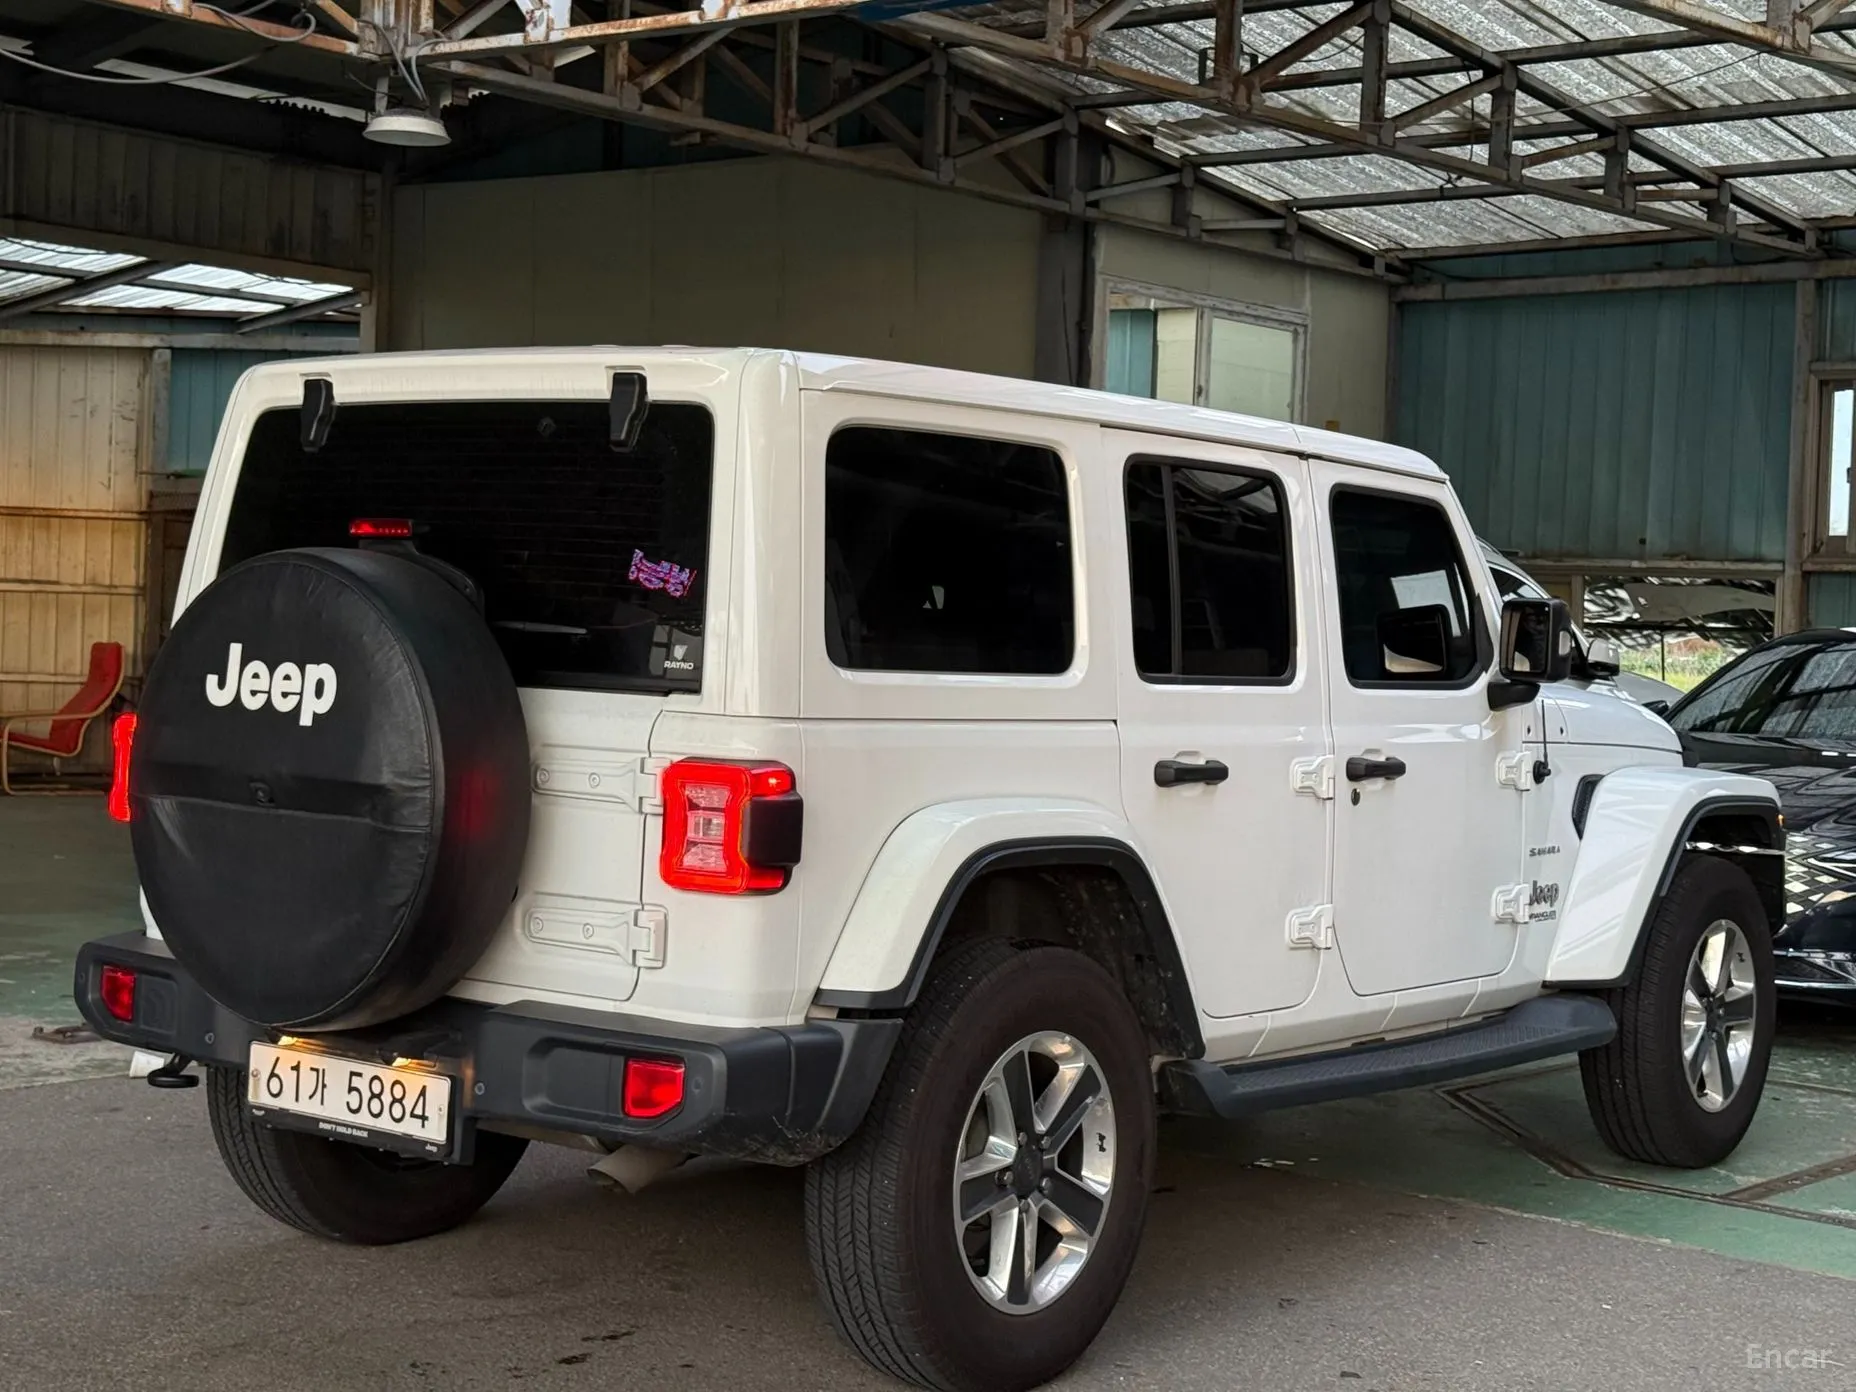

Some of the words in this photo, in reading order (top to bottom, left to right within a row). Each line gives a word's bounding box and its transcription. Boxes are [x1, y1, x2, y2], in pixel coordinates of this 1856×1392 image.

[664, 660, 694, 670] RAYNO
[206, 642, 337, 726] Jeep
[1529, 845, 1560, 857] SAHARA
[1529, 880, 1560, 907] Jeep
[266, 1056, 327, 1106] 61가
[346, 1070, 429, 1128] 5884
